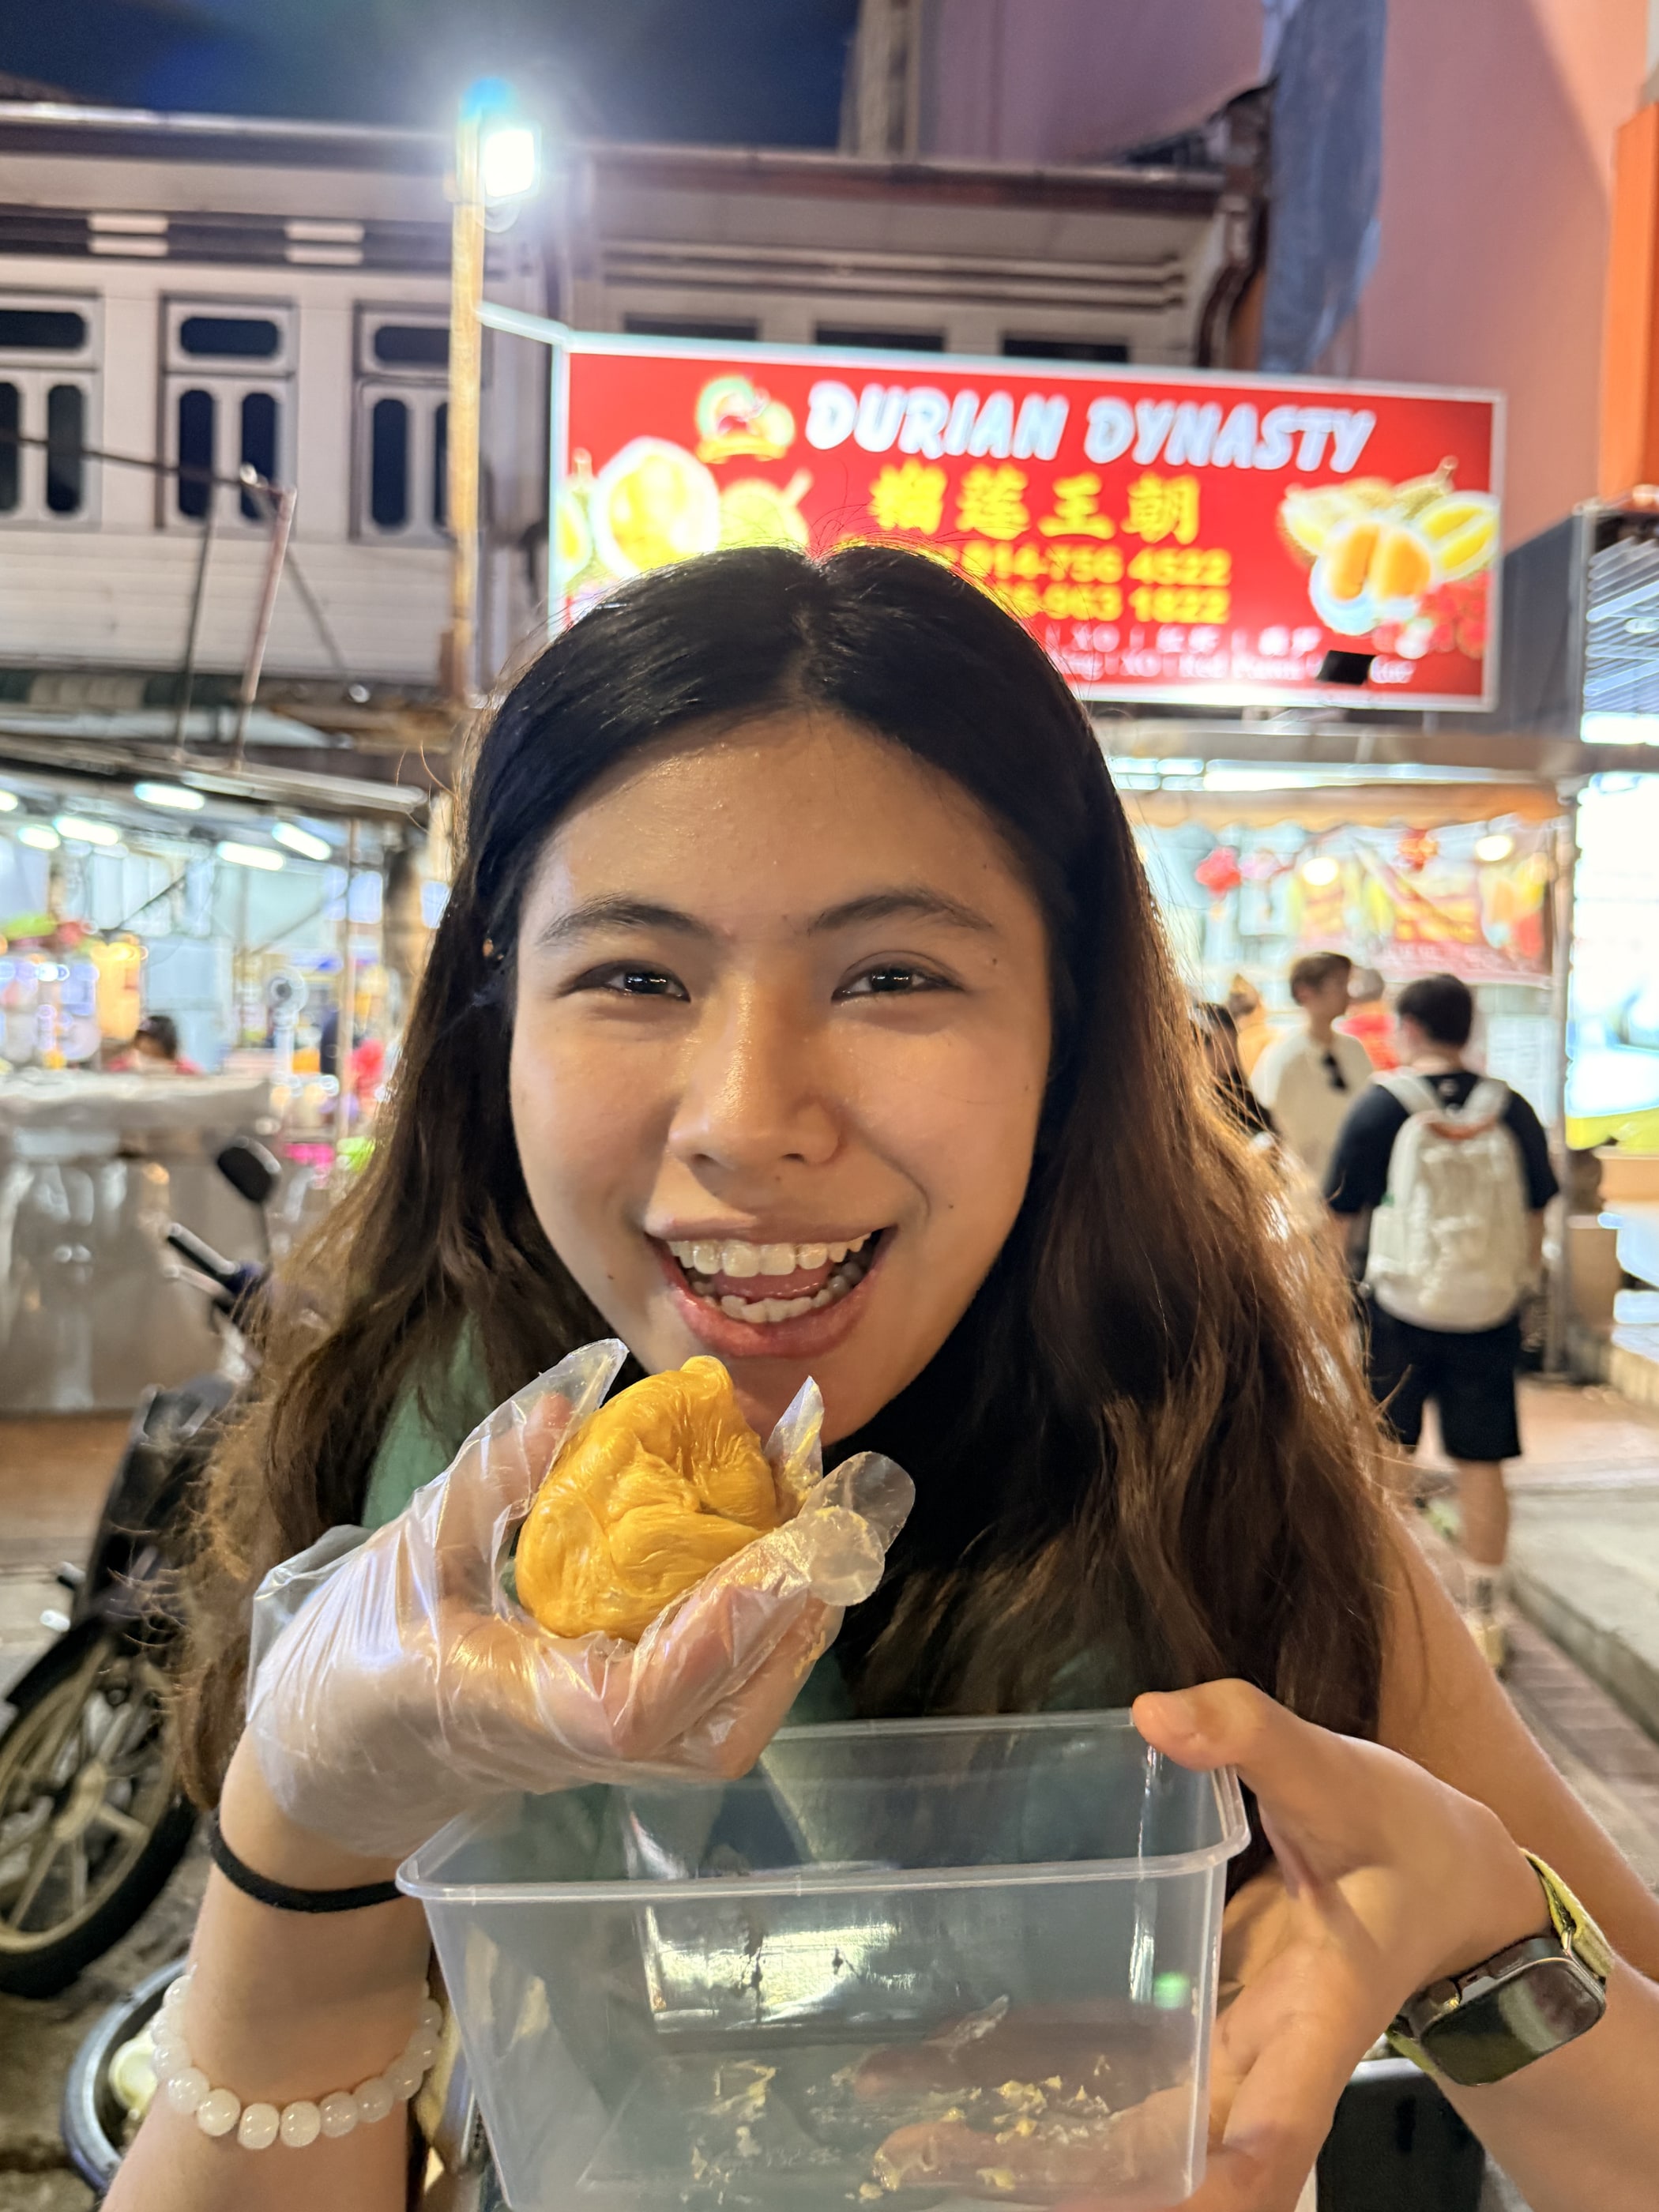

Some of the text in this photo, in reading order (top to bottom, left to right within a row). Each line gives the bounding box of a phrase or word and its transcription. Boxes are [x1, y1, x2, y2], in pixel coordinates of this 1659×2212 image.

[807, 381, 1376, 472] DURIAN DYNASTY
[1127, 547, 1232, 586] 4522
